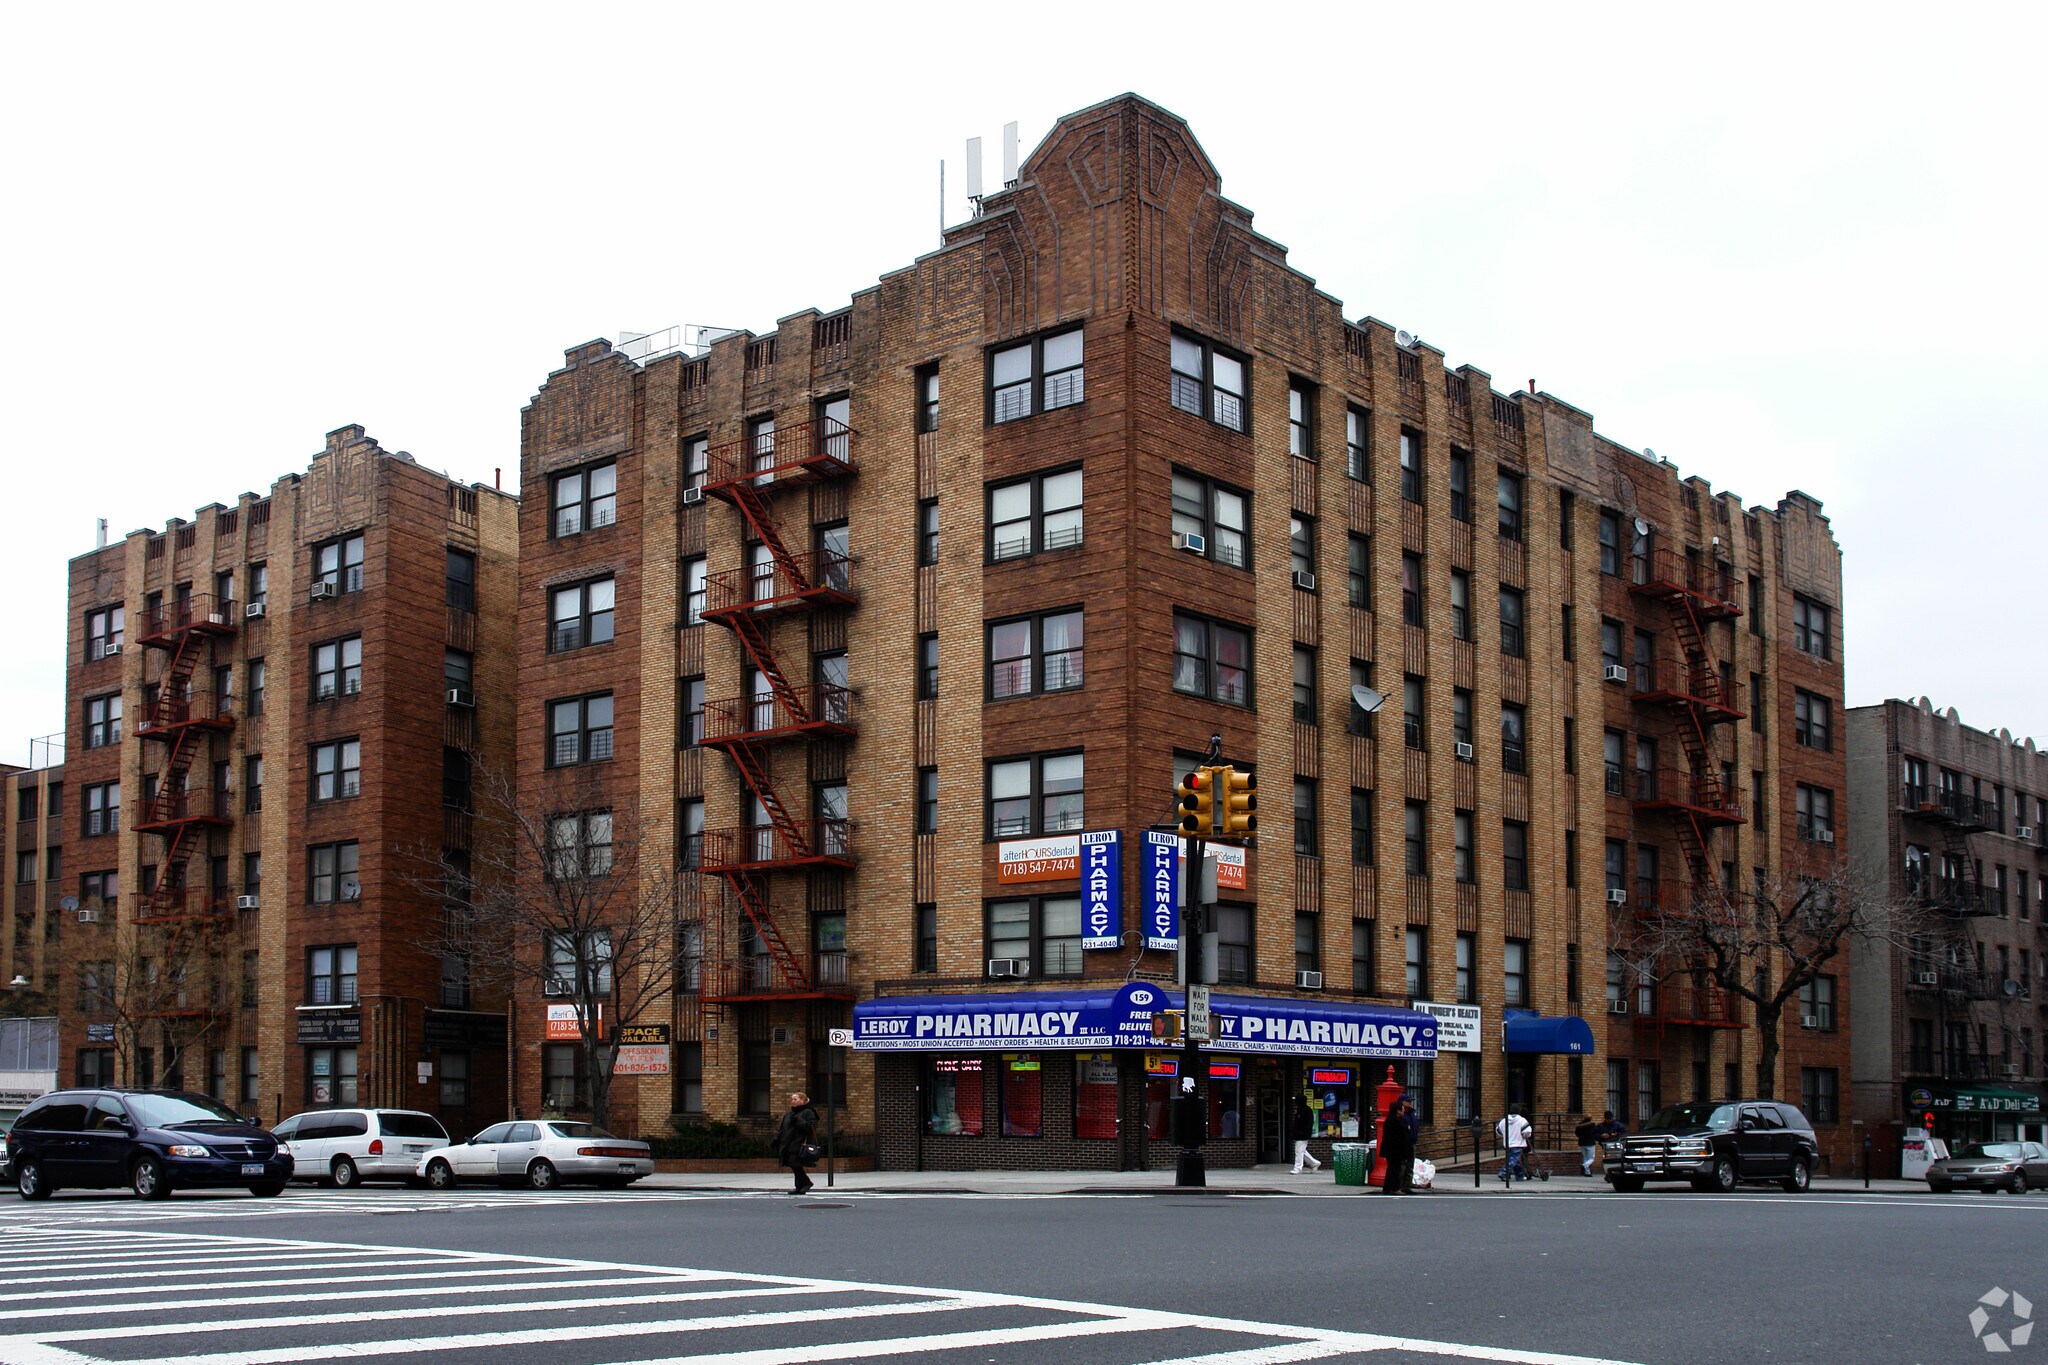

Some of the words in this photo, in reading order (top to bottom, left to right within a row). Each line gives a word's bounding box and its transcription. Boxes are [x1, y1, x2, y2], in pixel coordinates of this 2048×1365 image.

[1084, 832, 1114, 844] LEROY
[1151, 832, 1176, 845] LEROY
[1004, 845, 1076, 861] afterHOURSdental
[1003, 863, 1028, 877] (718)
[1029, 859, 1076, 873] 547-7474
[1090, 845, 1108, 936] PHARMACY
[1155, 846, 1171, 938] PHARMACY
[1083, 940, 1117, 949] 231-4040
[1150, 940, 1178, 950] 231-4040
[1134, 993, 1150, 1002] 159
[1192, 991, 1206, 1000] WAIT
[1194, 1003, 1205, 1012] FOR
[1130, 1011, 1152, 1020] FREE
[1191, 1014, 1207, 1023] WALK
[1458, 1008, 1479, 1019] HEALTH
[550, 1021, 568, 1031] (718)
[861, 1020, 909, 1034] LEROY
[916, 1011, 1080, 1037] PHARMACY
[1079, 1027, 1088, 1035] III
[1091, 1026, 1106, 1035] LLC
[1119, 1022, 1153, 1031] DELIVE
[621, 1027, 660, 1036] SPACE
[1190, 1025, 1209, 1035] SIGNAL
[1241, 1016, 1417, 1047] PHARMACY
[943, 1039, 974, 1047] ACCEPTED
[1004, 1038, 1029, 1046] ORDERS
[1034, 1038, 1059, 1046] HEALTH
[1060, 1038, 1065, 1046] &
[1094, 1037, 1110, 1045] AIDS
[1243, 1042, 1265, 1050] CHAIRS
[1399, 1049, 1436, 1057] 718-231-4040
[2004, 1098, 2020, 1110] Deli
